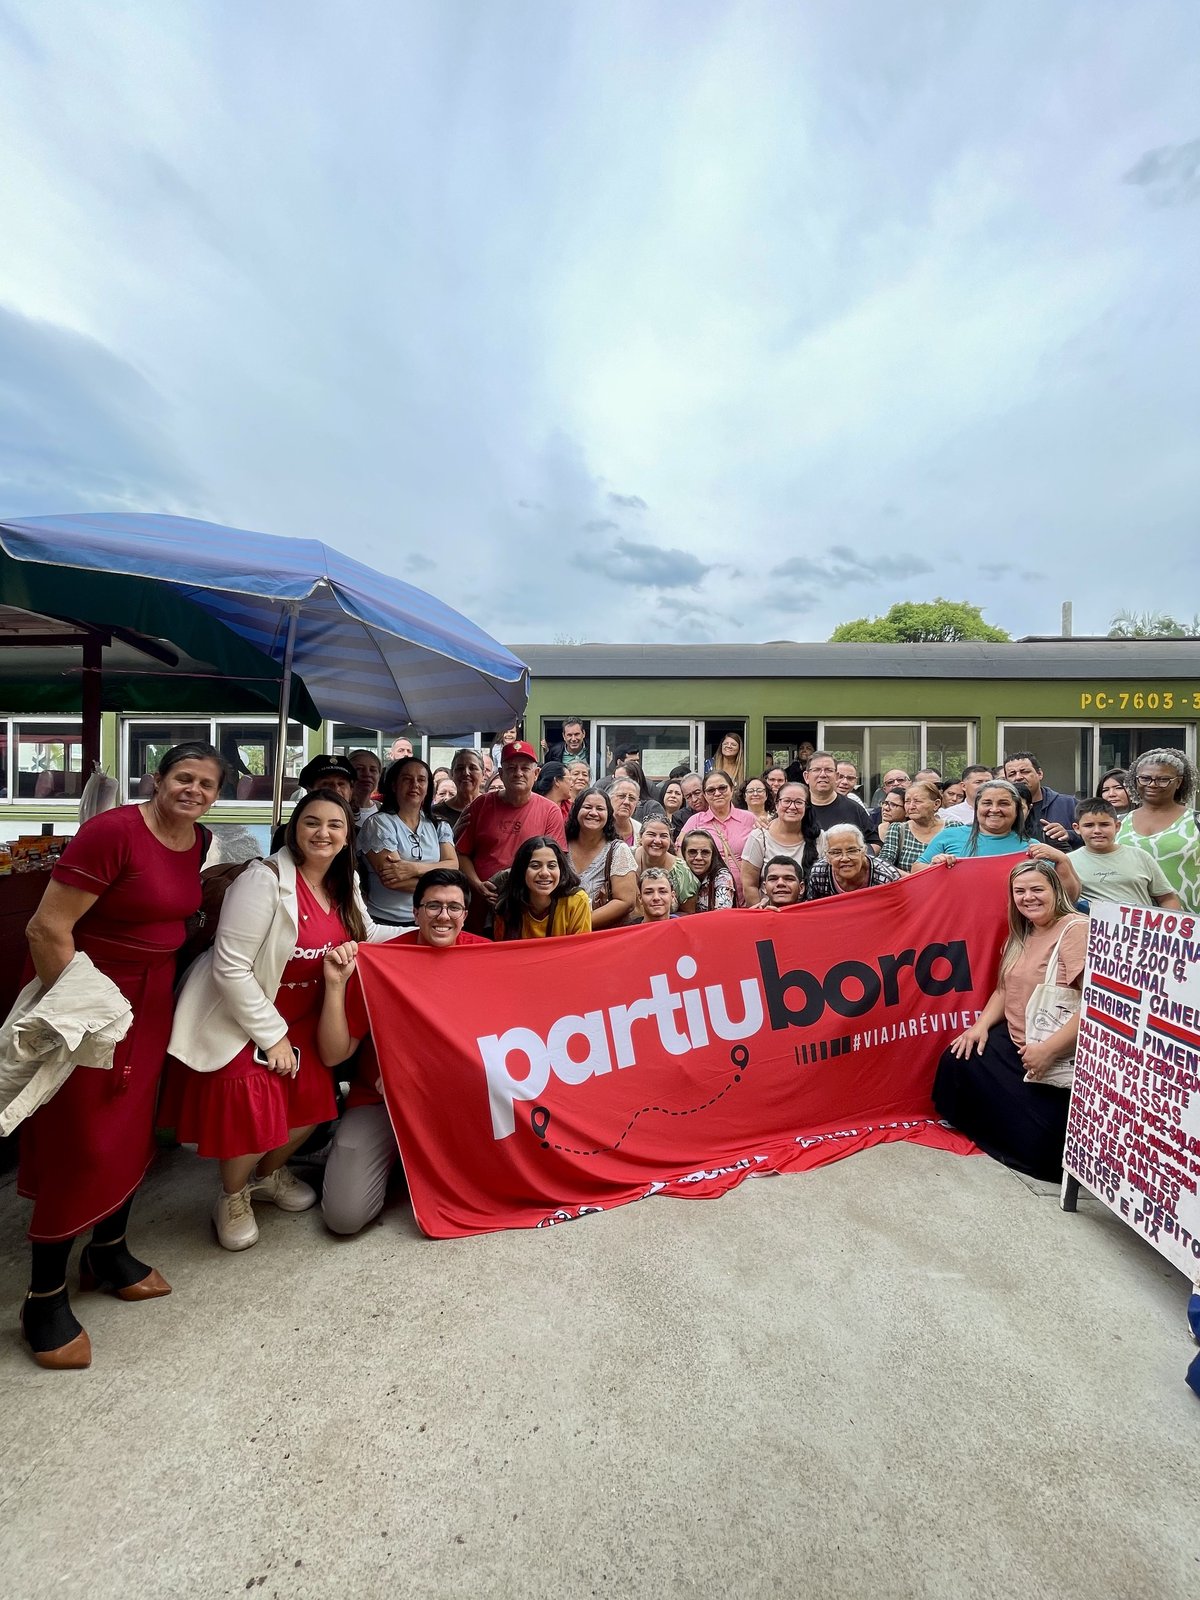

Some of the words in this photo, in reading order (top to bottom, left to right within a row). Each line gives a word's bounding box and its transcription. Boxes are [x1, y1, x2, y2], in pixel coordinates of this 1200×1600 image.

[1090, 918, 1119, 941] BALA
[1121, 925, 1140, 948] DE
[1141, 929, 1200, 963] BANANA
[1120, 906, 1195, 939] TEMOS
[289, 942, 334, 960] parti
[1088, 935, 1111, 957] 500
[1126, 945, 1134, 966] E
[1136, 949, 1169, 974] 200
[1088, 951, 1169, 998] TRADICIONAL
[1084, 986, 1141, 1027] GENGIBRE
[1078, 1033, 1098, 1057] BALA
[1099, 1045, 1110, 1063] DE
[1142, 1069, 1150, 1087] E
[1152, 1074, 1190, 1109] LEITE
[1080, 1018, 1099, 1040] BALA
[1100, 1028, 1110, 1047] DE
[1110, 1034, 1144, 1067] BANANA
[1145, 1053, 1175, 1081] ZERO
[1142, 1030, 1200, 1074] PIMEN
[1073, 1079, 1096, 1106] CHIPS
[1099, 1097, 1110, 1117] DE
[1074, 1065, 1094, 1088] CHIPS
[1094, 1076, 1103, 1095] DE
[1075, 1047, 1117, 1088] BANANA
[1122, 1073, 1181, 1126] PASSAS
[1071, 1092, 1104, 1128] MELADO
[1106, 1118, 1120, 1140] DE
[1069, 1105, 1180, 1202] REFRIGERANTES
[1127, 1168, 1179, 1220] MINERAL
[1120, 1196, 1130, 1217] E
[1134, 1207, 1160, 1244] PIX
